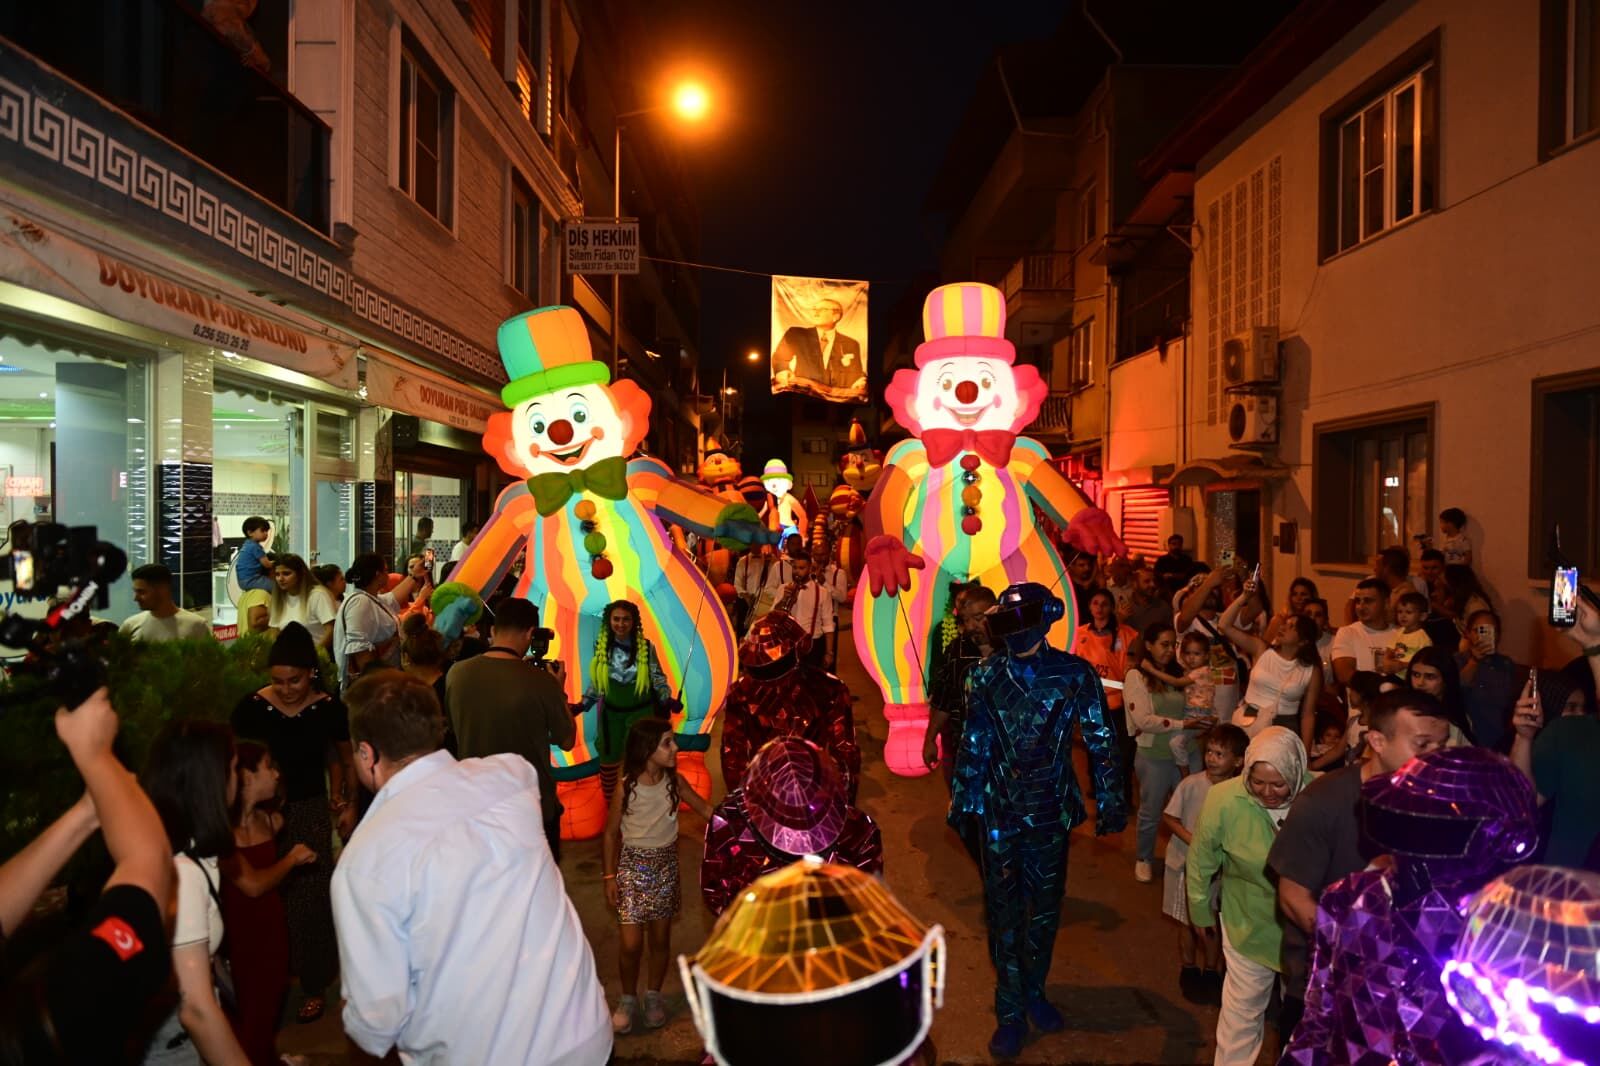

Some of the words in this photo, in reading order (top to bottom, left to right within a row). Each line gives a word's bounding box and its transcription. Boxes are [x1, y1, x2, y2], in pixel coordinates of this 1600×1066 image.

[568, 227, 589, 250] DİŞ
[592, 227, 636, 246] HEKİMİ
[594, 249, 616, 261] Fidan
[618, 249, 636, 261] TOY
[97, 254, 206, 320] DOYURAN
[249, 314, 308, 354] SALONU
[420, 384, 454, 412] DOYURAN
